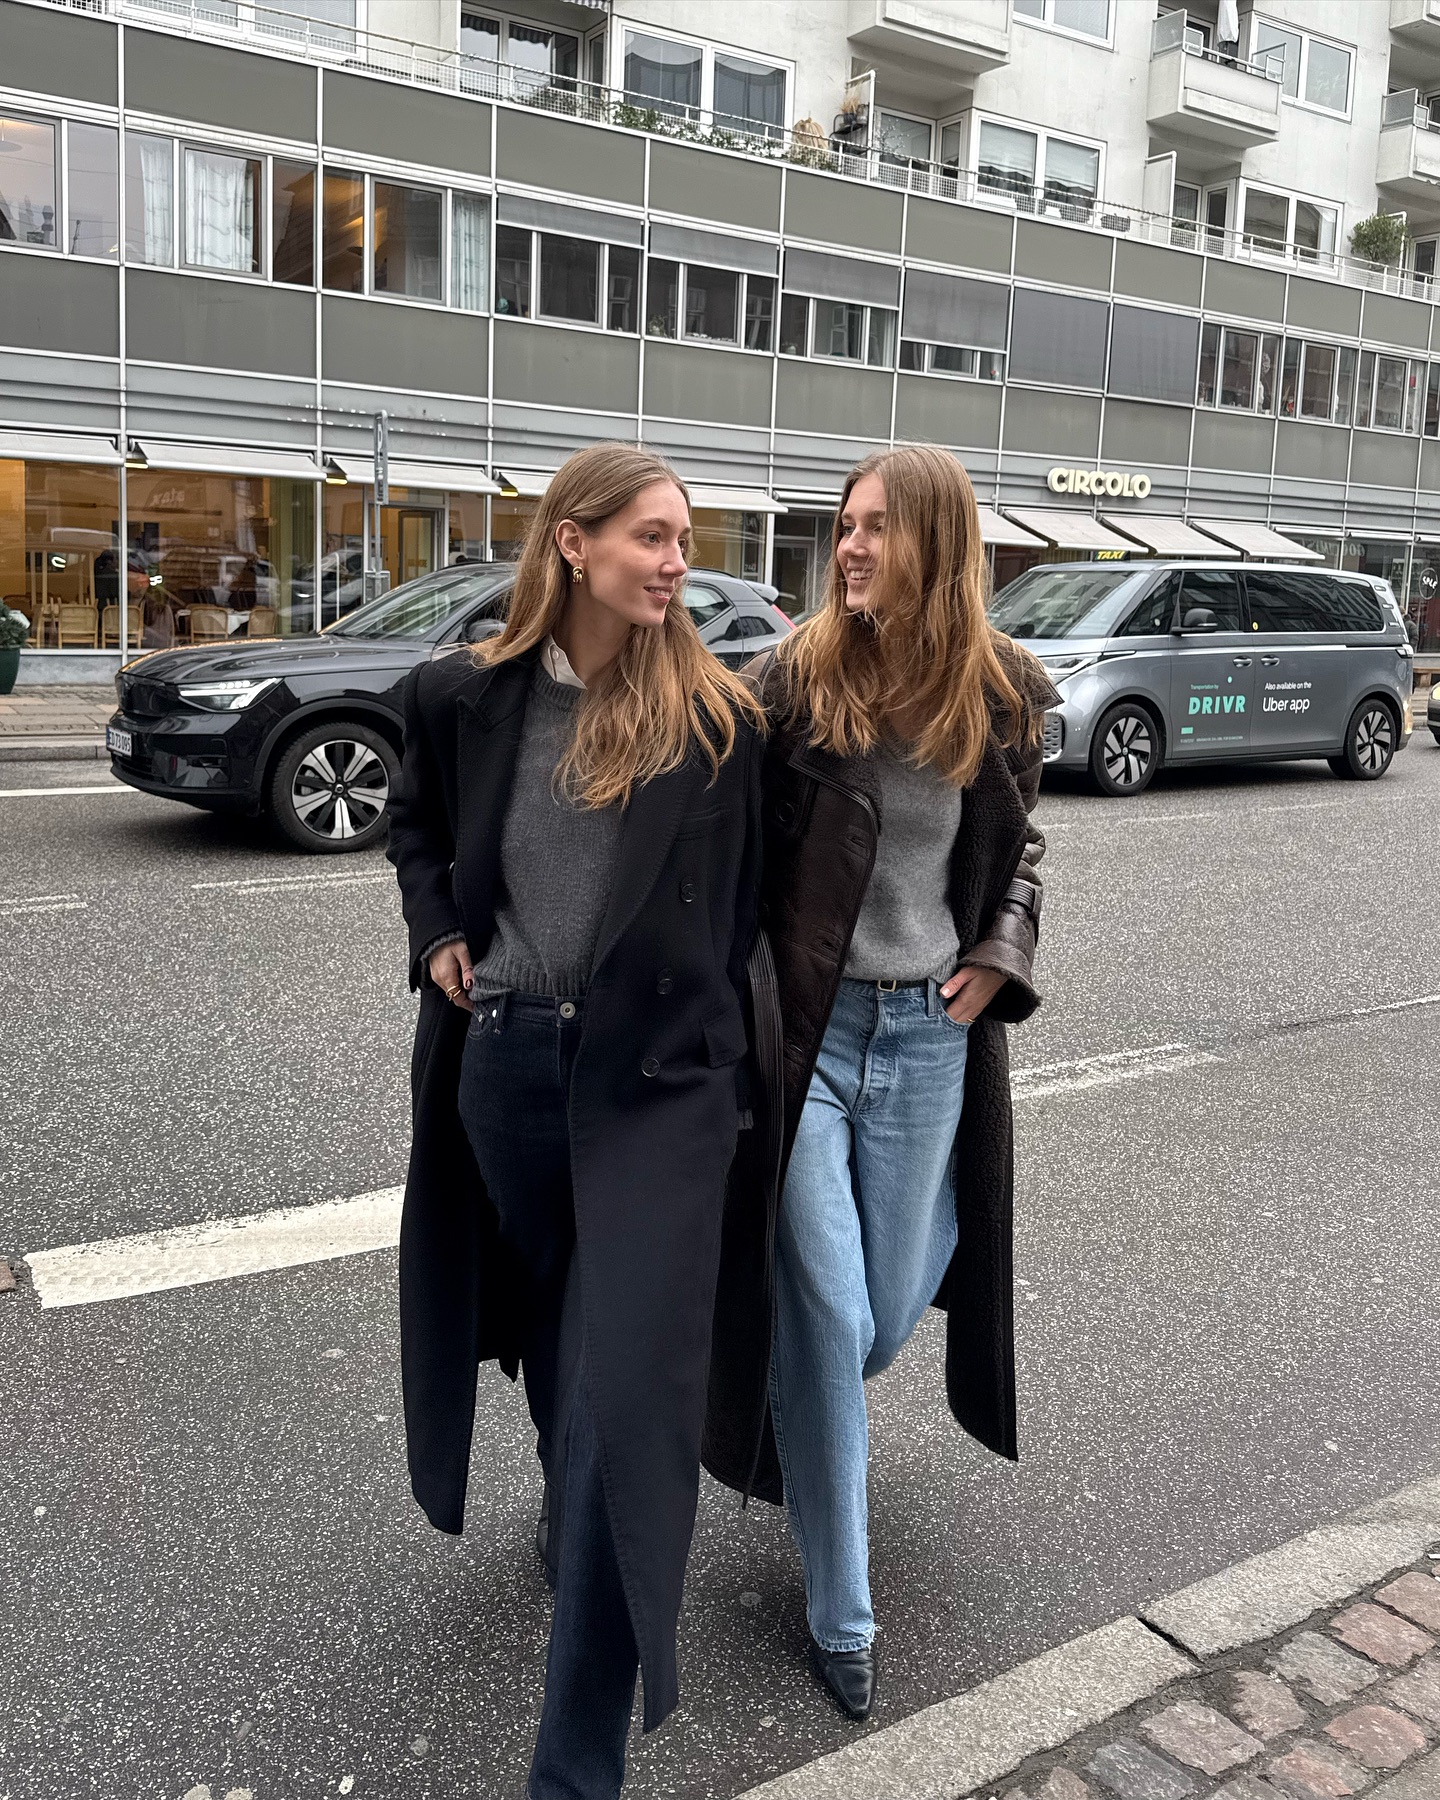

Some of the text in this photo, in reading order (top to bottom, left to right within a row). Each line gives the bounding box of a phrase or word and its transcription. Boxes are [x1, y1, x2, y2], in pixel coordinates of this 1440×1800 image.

[1047, 467, 1152, 499] CIRCOLO
[1097, 550, 1126, 560] TAXI
[1264, 682, 1276, 691] Also
[1276, 682, 1296, 690] available
[1303, 681, 1312, 689] the
[1188, 695, 1246, 715] DRIVR
[1262, 696, 1311, 714] Uber app
